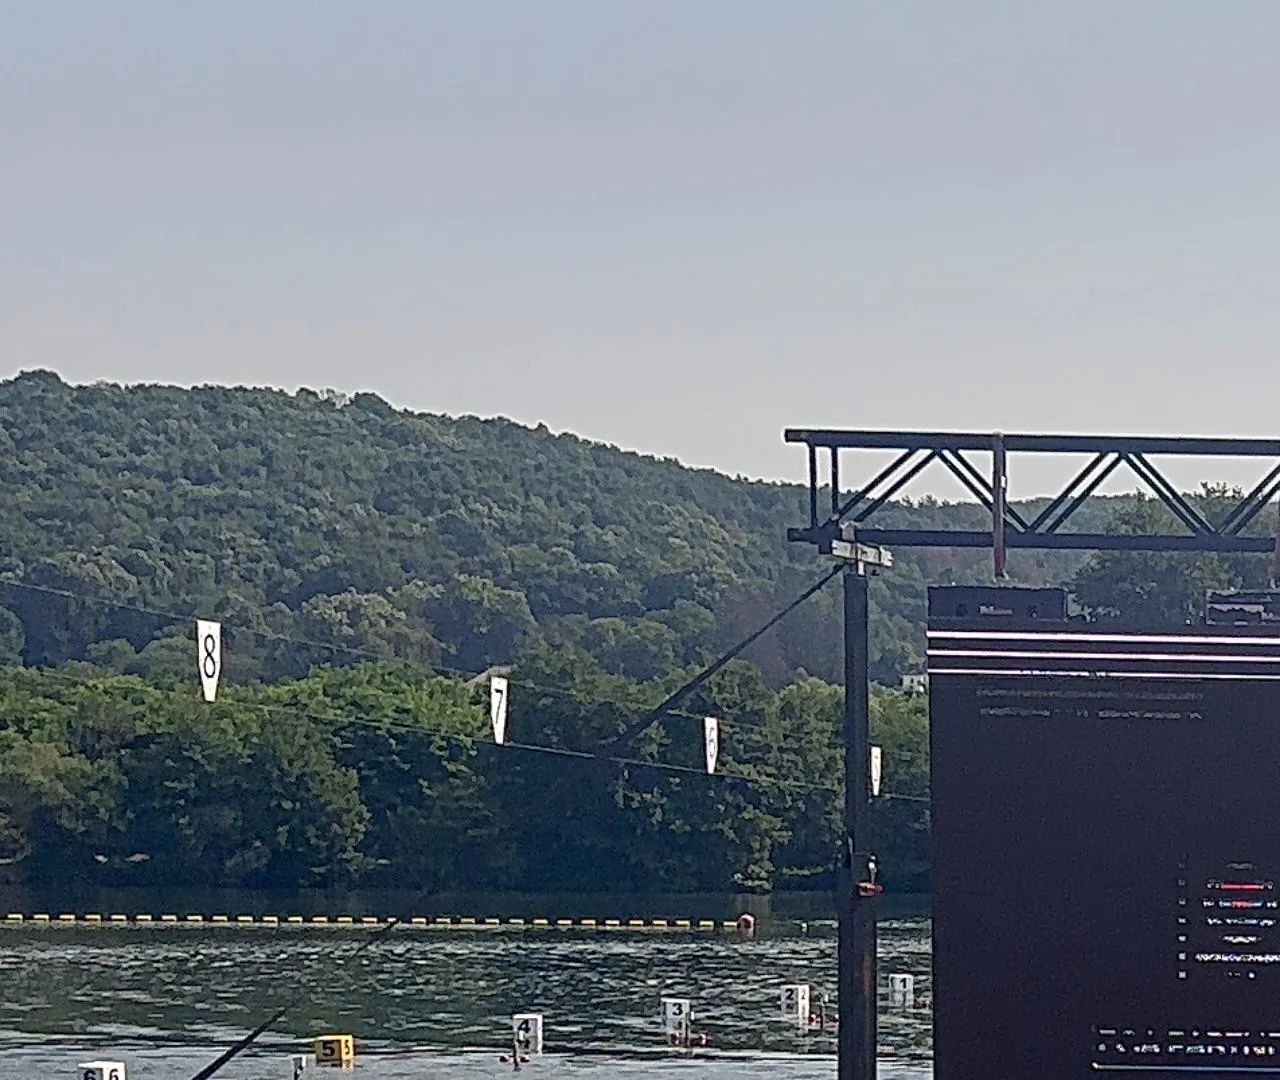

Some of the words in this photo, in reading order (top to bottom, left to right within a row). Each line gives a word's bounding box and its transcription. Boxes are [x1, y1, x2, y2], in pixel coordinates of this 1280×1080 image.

[203, 633, 216, 679] 8
[494, 688, 504, 725] 7
[900, 977, 907, 989] 1
[785, 987, 794, 1001] 2
[671, 1002, 683, 1016] 3
[517, 1019, 531, 1034] 4
[322, 1040, 336, 1057] 5
